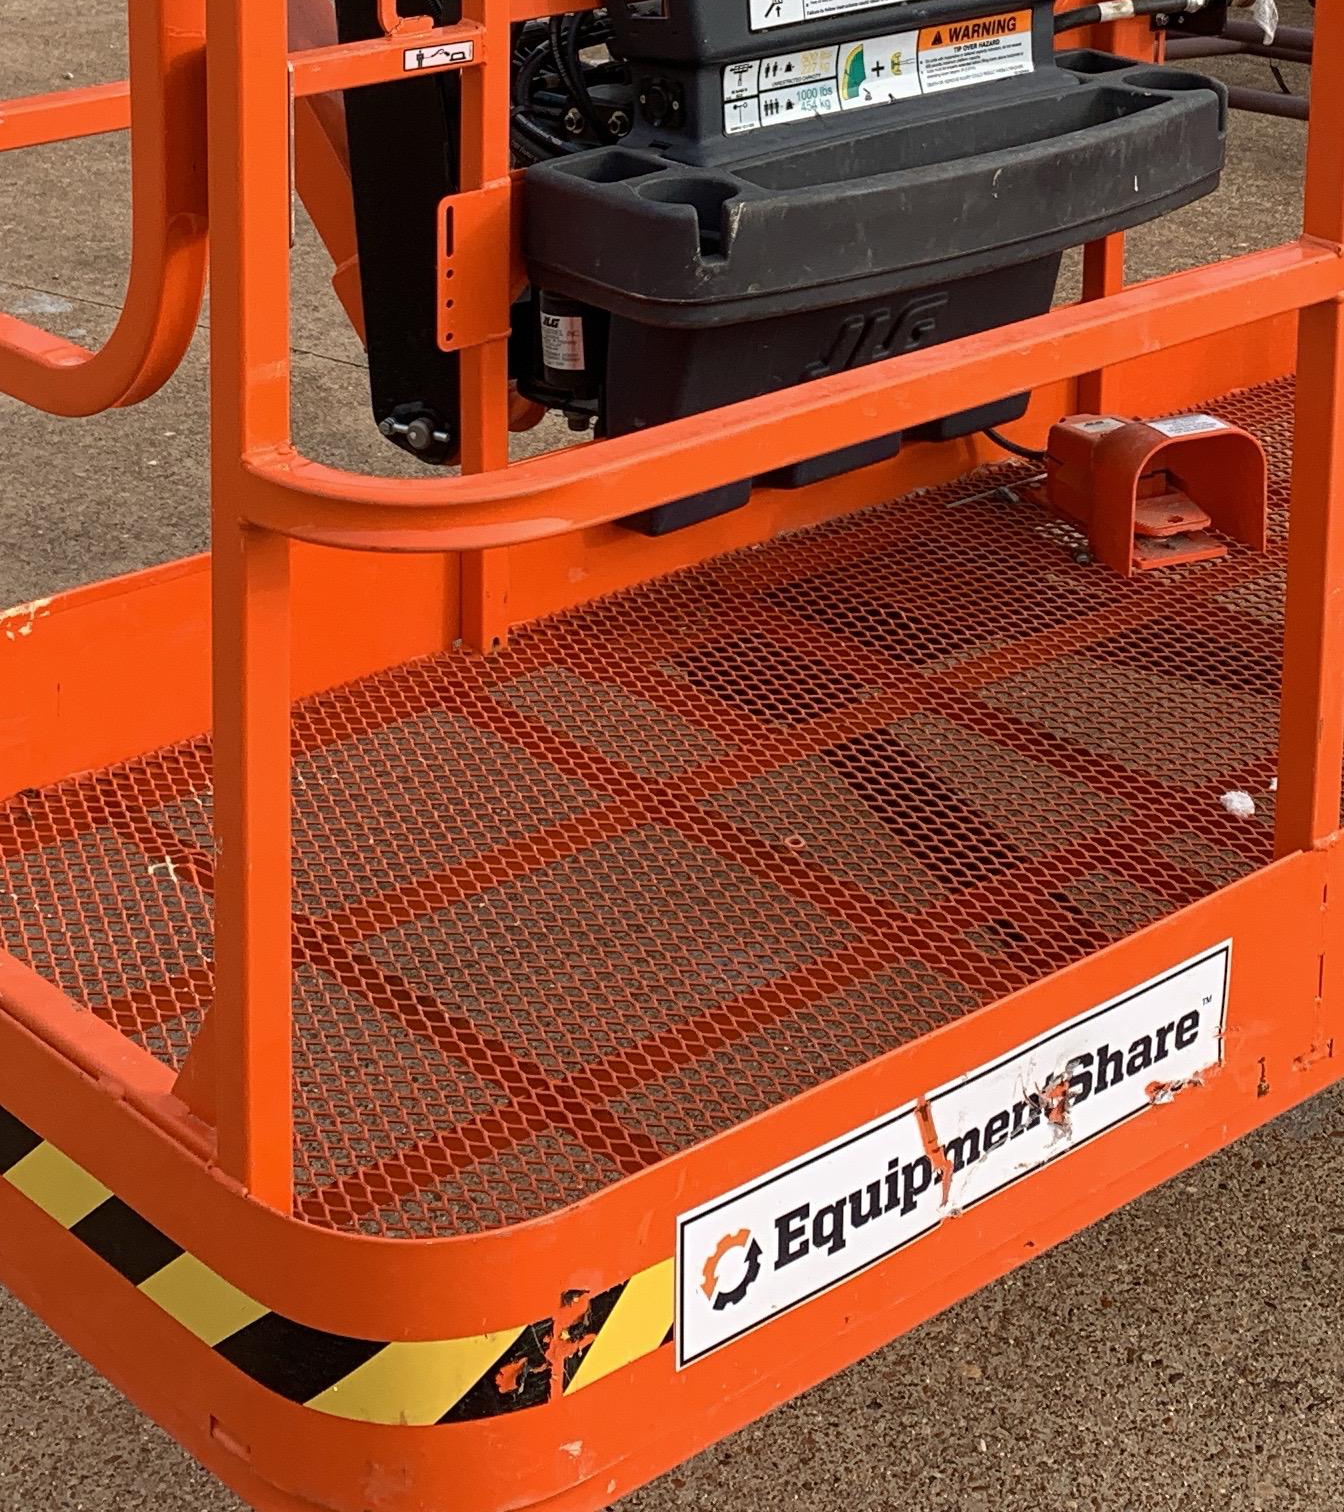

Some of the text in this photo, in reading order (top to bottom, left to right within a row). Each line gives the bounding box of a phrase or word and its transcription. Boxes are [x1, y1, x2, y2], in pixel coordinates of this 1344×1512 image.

[948, 16, 1017, 43] WARNING
[978, 39, 1000, 48] HAZARD
[796, 85, 833, 102] 1000 lbs
[820, 98, 832, 111] kg
